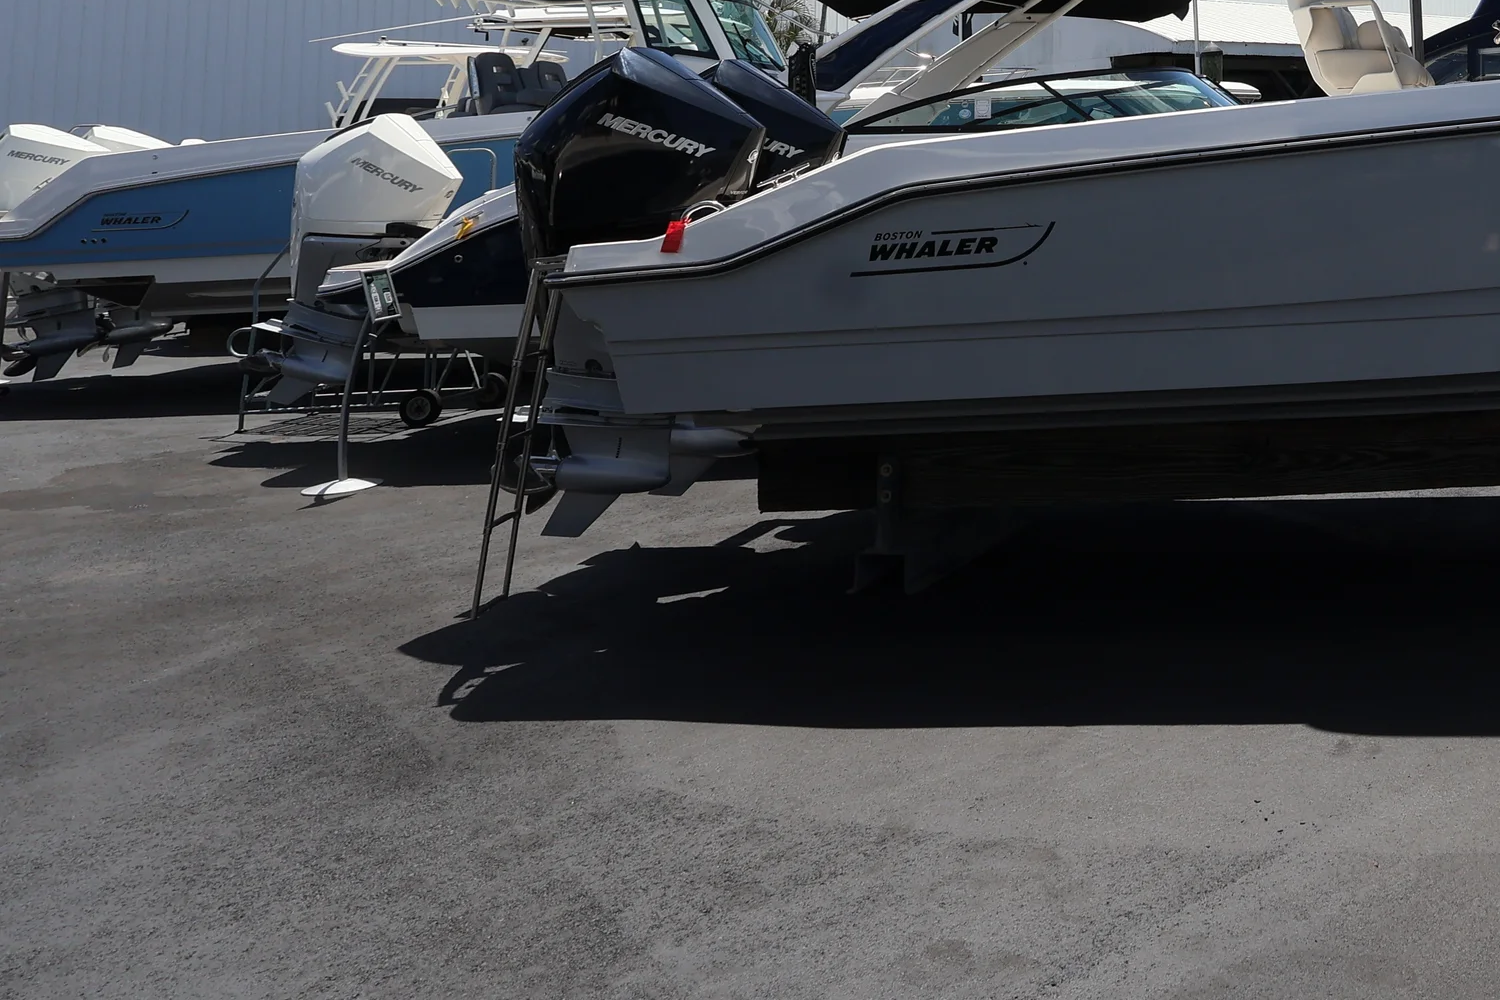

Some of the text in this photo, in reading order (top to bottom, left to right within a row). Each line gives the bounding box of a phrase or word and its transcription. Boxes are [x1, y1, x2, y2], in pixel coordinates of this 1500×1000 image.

[597, 113, 716, 158] MERCURY
[7, 150, 71, 166] MERCURY
[351, 157, 424, 193] MERCURY
[100, 216, 162, 226] WHALER
[874, 230, 923, 242] BOSTON
[869, 236, 999, 262] WHALER
